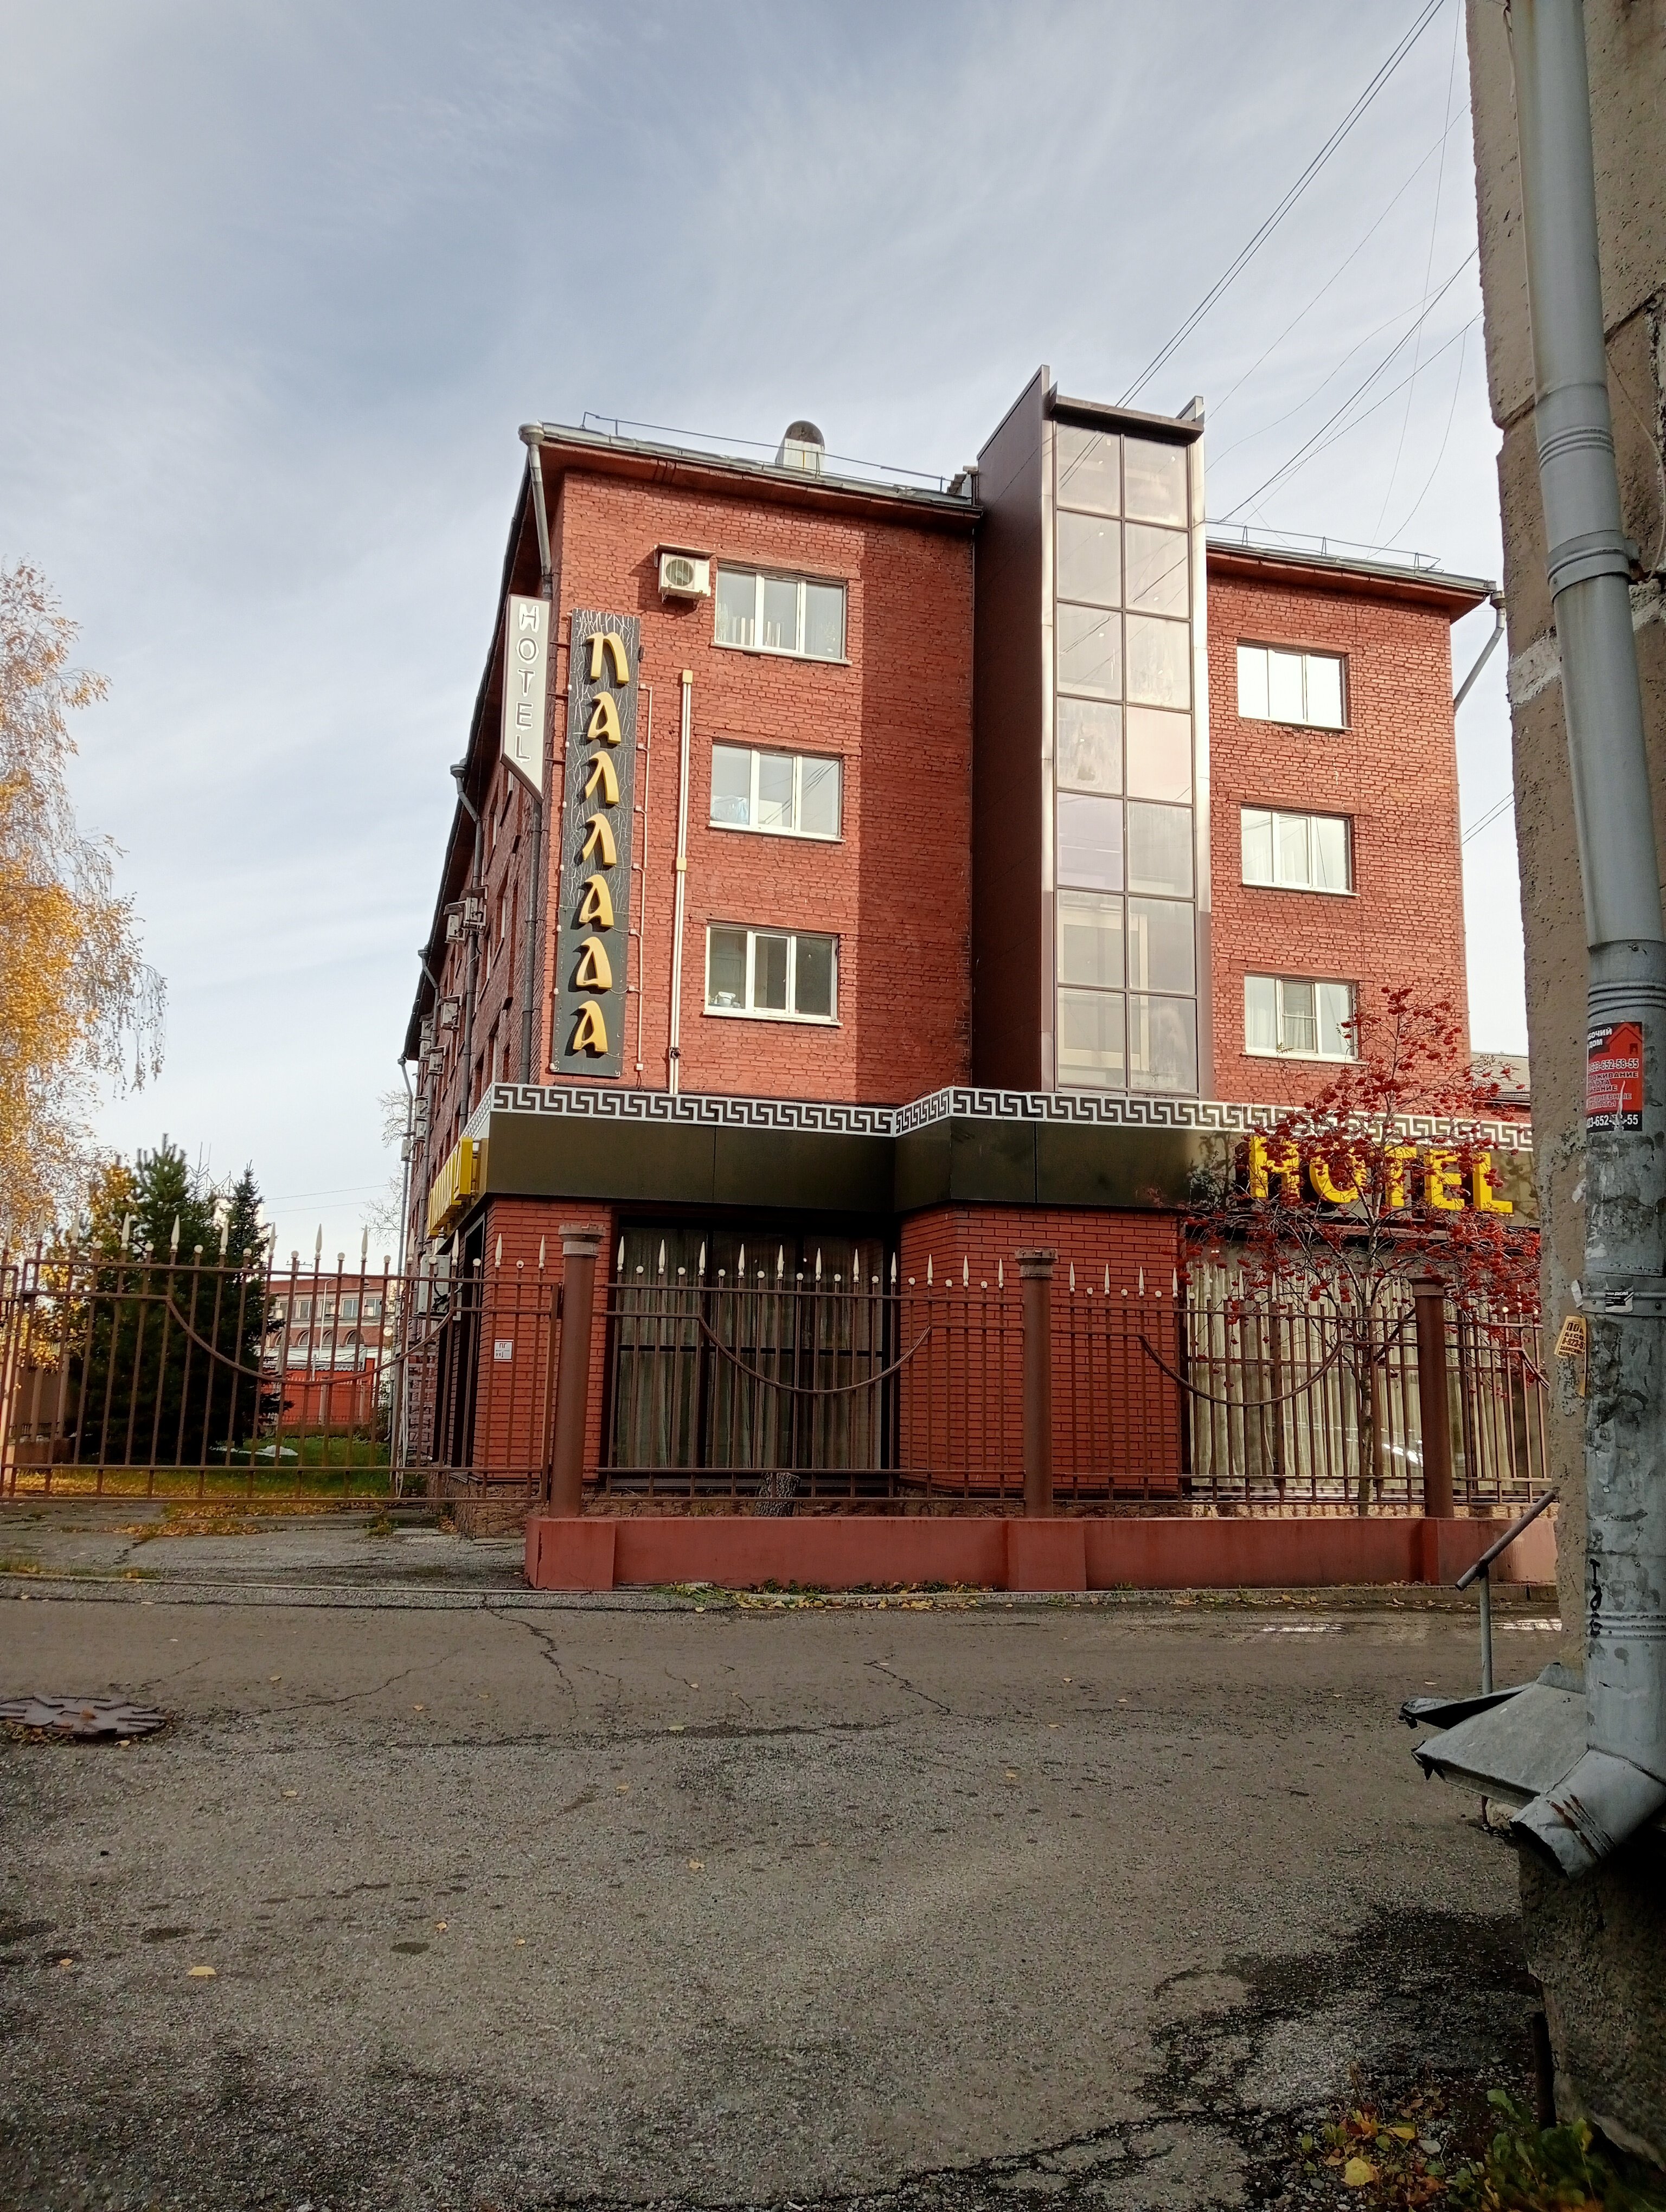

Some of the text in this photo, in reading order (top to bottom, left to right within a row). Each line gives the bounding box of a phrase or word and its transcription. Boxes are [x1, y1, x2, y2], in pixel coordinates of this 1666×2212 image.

[515, 603, 540, 763] HOTEL
[572, 631, 630, 1053] ПАЛЛАДА
[1588, 1072, 1639, 1081] РОЖИВАНИЕ
[1589, 1038, 1603, 1049] ДОМ
[1249, 1136, 1513, 1214] HOTEL
